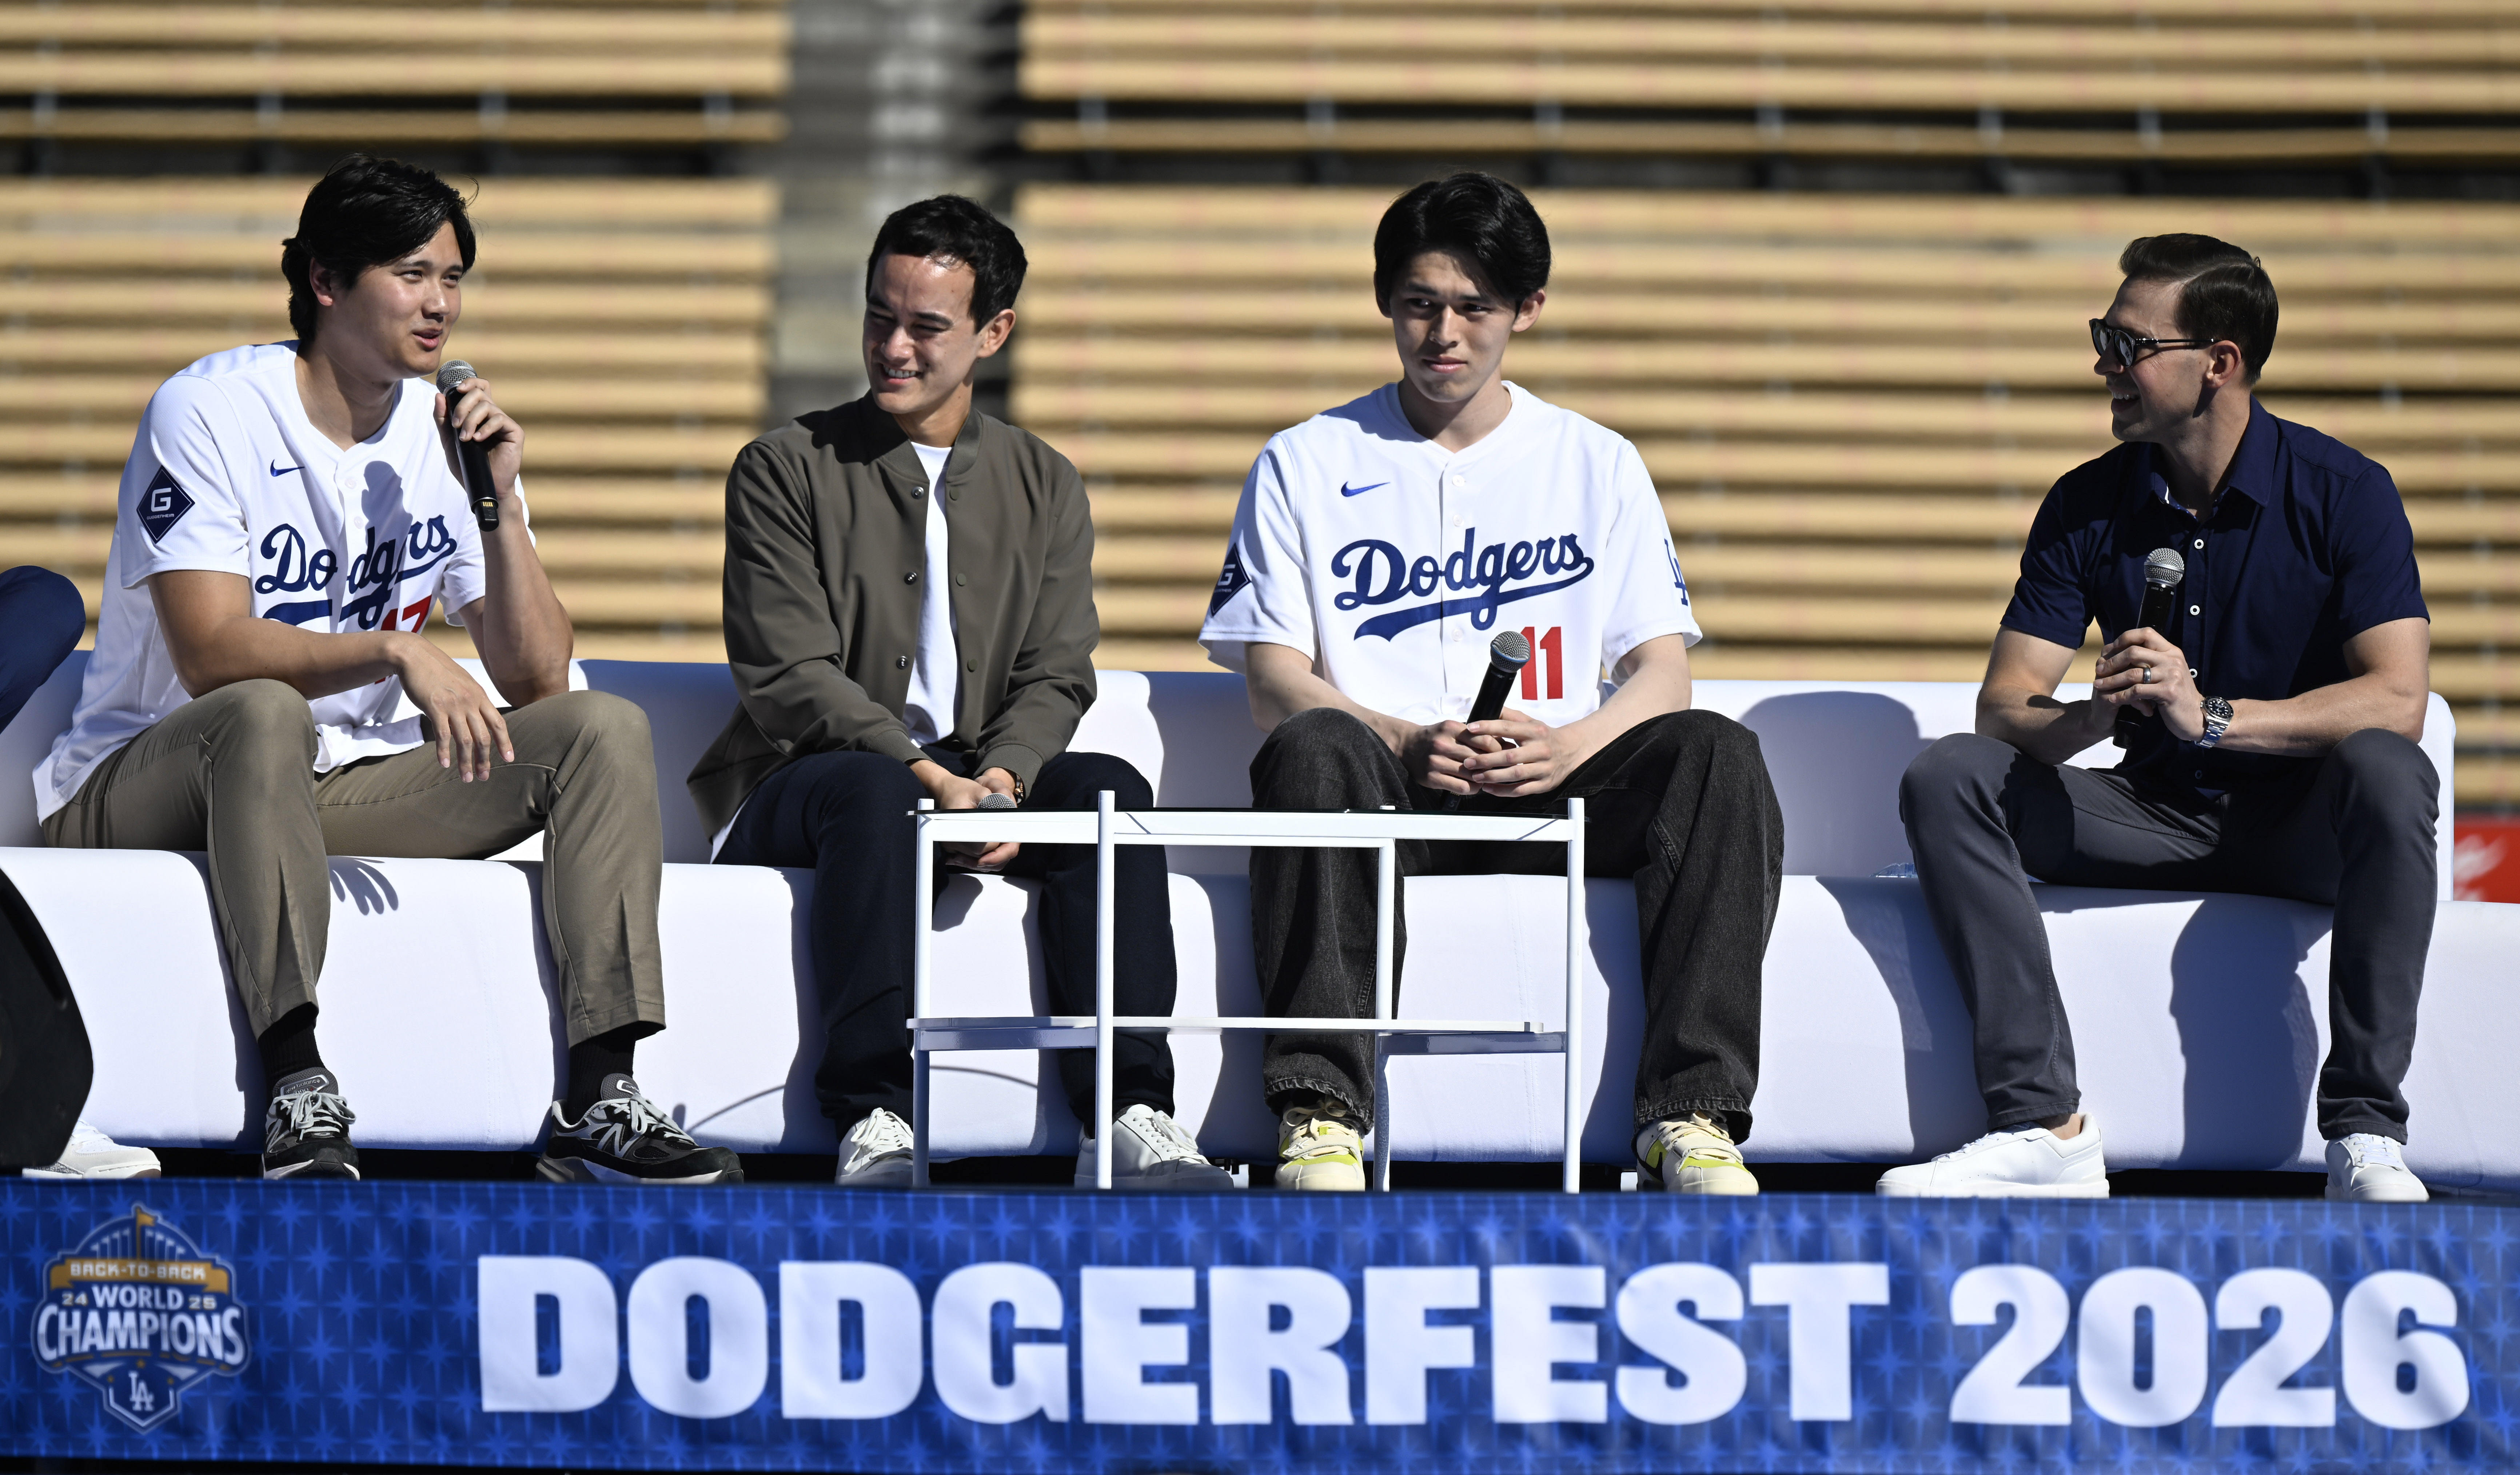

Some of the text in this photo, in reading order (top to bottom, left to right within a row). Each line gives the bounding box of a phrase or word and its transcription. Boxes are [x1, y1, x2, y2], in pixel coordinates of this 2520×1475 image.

[151, 487, 171, 512] G
[255, 514, 457, 630] Dodgrs
[1217, 564, 1236, 586] G
[1331, 527, 1595, 630] Dodgers
[1520, 626, 1563, 700] 11
[296, 1079, 320, 1088] balance
[70, 1264, 206, 1280] BACK-TO-BACK
[62, 1285, 216, 1310] 24 WORLD 25
[37, 1304, 245, 1365] CHAMPIONS
[478, 1255, 2470, 1430] DODGERFEST 2026
[128, 1372, 155, 1411] LA
